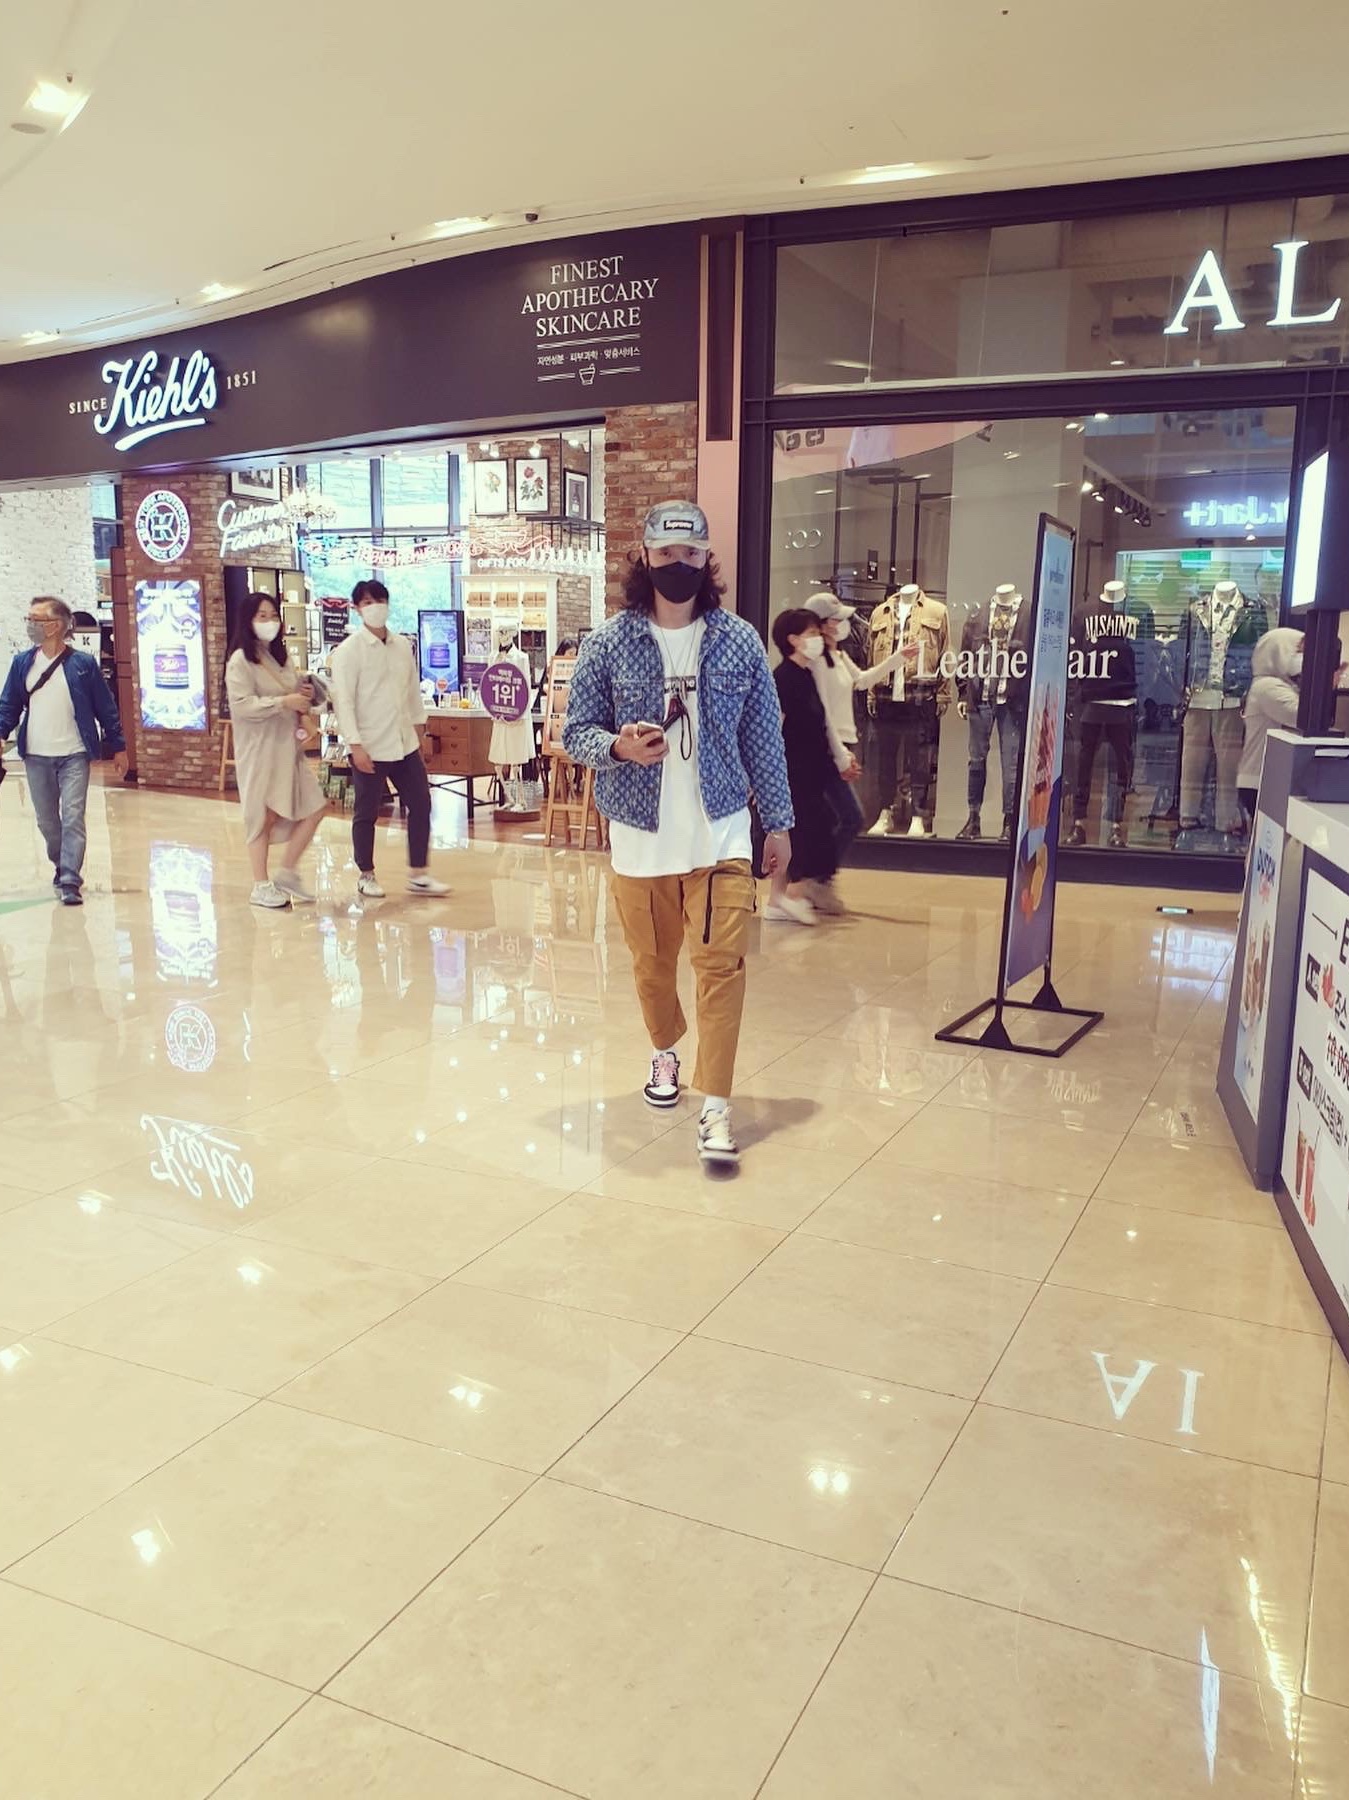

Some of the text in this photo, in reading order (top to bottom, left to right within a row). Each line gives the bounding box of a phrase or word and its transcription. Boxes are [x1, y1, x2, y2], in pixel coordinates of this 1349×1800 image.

[550, 255, 624, 285] FINEST
[1163, 239, 1342, 335] AL
[521, 278, 660, 314] APOTHECARY
[536, 306, 641, 337] SKINCARE
[69, 349, 257, 435] SINCE Kiehl's 1851
[914, 637, 1119, 680] Leathe air
